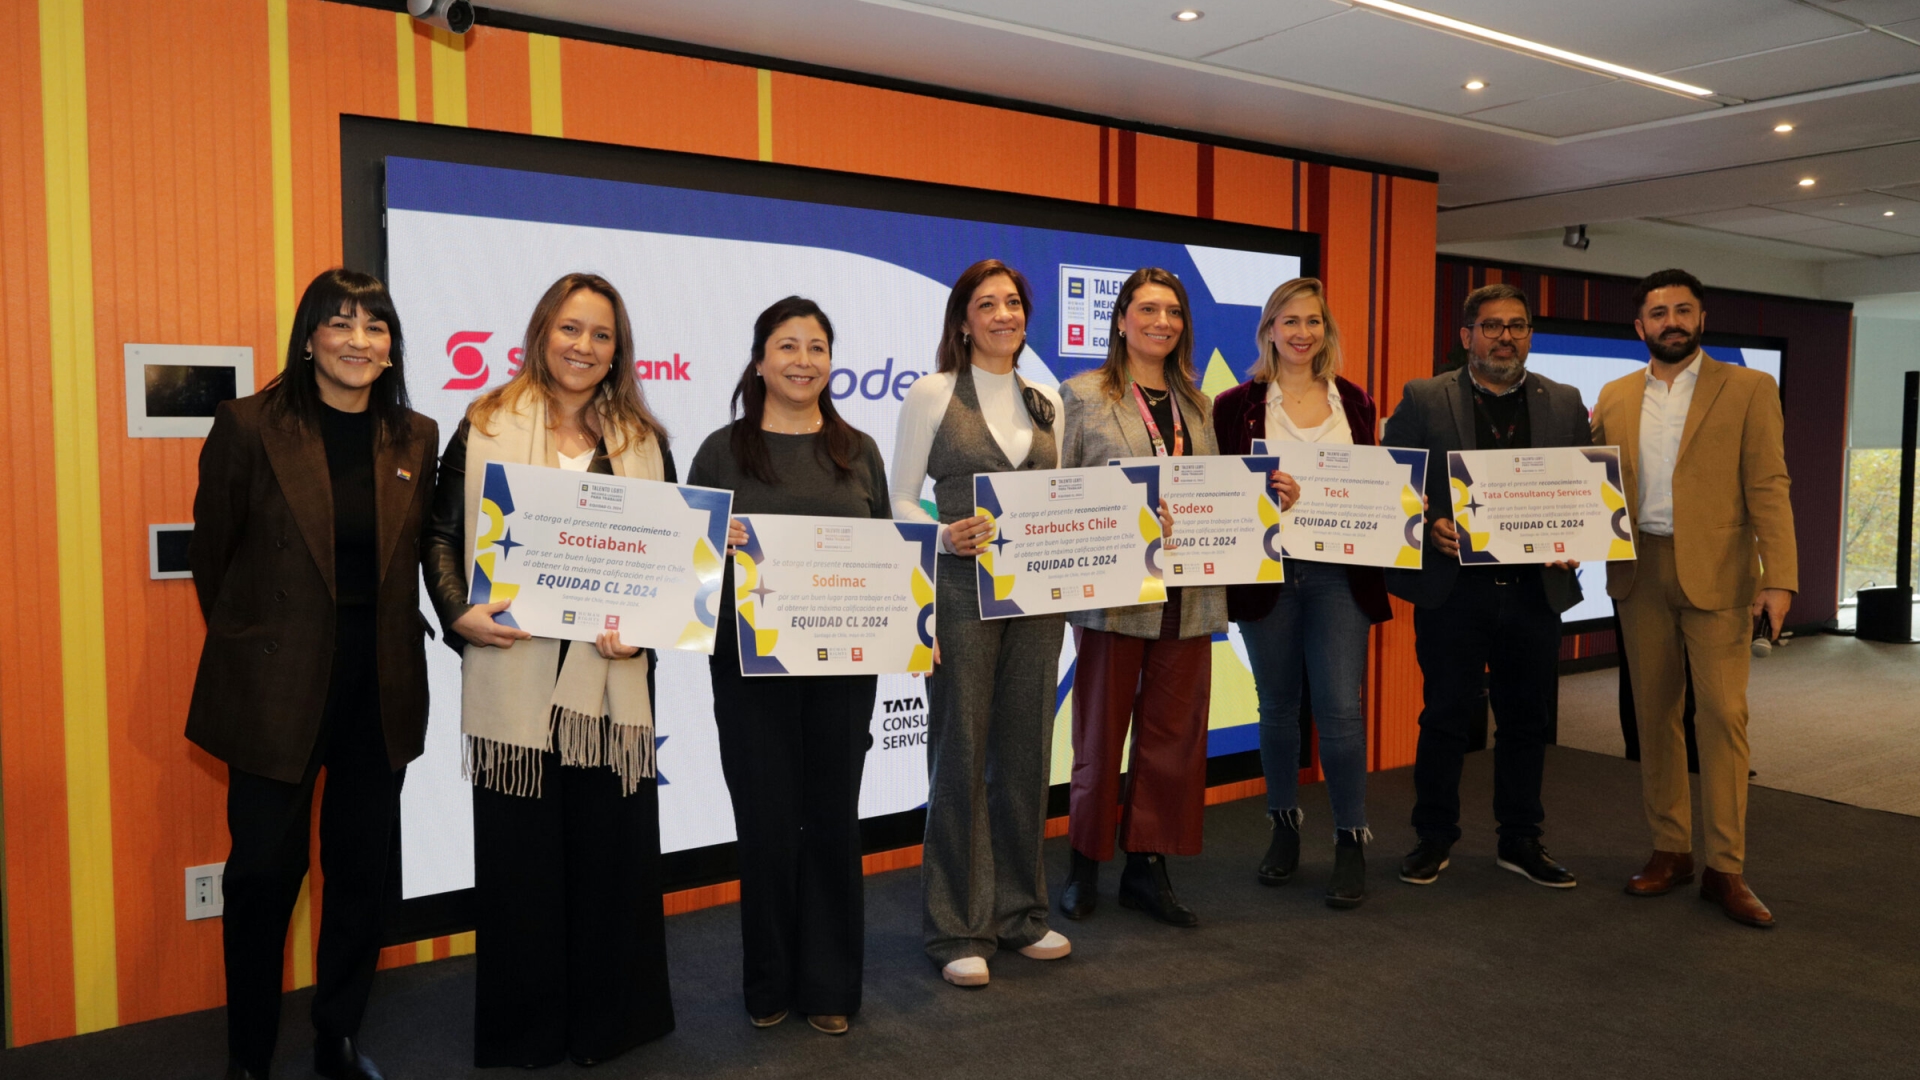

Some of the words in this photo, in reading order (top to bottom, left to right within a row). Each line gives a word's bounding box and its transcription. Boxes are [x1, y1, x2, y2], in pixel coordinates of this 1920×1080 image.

[829, 358, 928, 402] ode
[1324, 487, 1349, 498] Teck
[1504, 490, 1555, 499] Consultancy
[1047, 508, 1074, 517] presente
[1074, 505, 1121, 514] reconocimiento
[1173, 503, 1214, 514] Sodexo
[523, 512, 533, 520] Se
[535, 514, 562, 524] otorga
[572, 520, 608, 529] presente
[609, 524, 672, 536] reconocimiento
[1025, 520, 1085, 535] Starbucks
[1088, 517, 1117, 530] Chile
[1294, 517, 1338, 528] EQUIDAD
[1340, 520, 1351, 529] CL
[1354, 521, 1378, 530] 2024
[1500, 521, 1544, 532] EQUIDAD
[1547, 520, 1558, 529] CL
[1561, 519, 1584, 528] 2024
[559, 532, 646, 554] Scotiabank
[1199, 537, 1210, 547] CL
[1213, 536, 1236, 546] 2024
[1074, 546, 1105, 554] calificación
[565, 552, 584, 561] buen
[585, 555, 605, 564] lugar
[625, 560, 656, 570] trabajar
[667, 564, 686, 573] Chile
[772, 559, 781, 567] Se
[782, 560, 805, 569] otorga
[1027, 558, 1075, 573] EQUIDAD
[1078, 557, 1089, 567] CL
[1092, 554, 1117, 566] 2024
[532, 561, 562, 570] obtener
[571, 566, 602, 575] máxima
[603, 569, 644, 580] calificación
[537, 574, 600, 591] EQUIDAD
[605, 581, 619, 594] CL
[624, 584, 657, 598] 2024
[812, 574, 866, 588] Sodimac
[827, 594, 843, 602] lugar
[859, 594, 883, 602] trabajar
[843, 605, 875, 613] calificación
[791, 616, 843, 630] EQUIDAD
[846, 616, 859, 628] CL
[862, 616, 888, 627] 2024
[883, 697, 924, 713] TATA
[883, 714, 928, 731] CONSU
[883, 732, 928, 750] SERVIC
